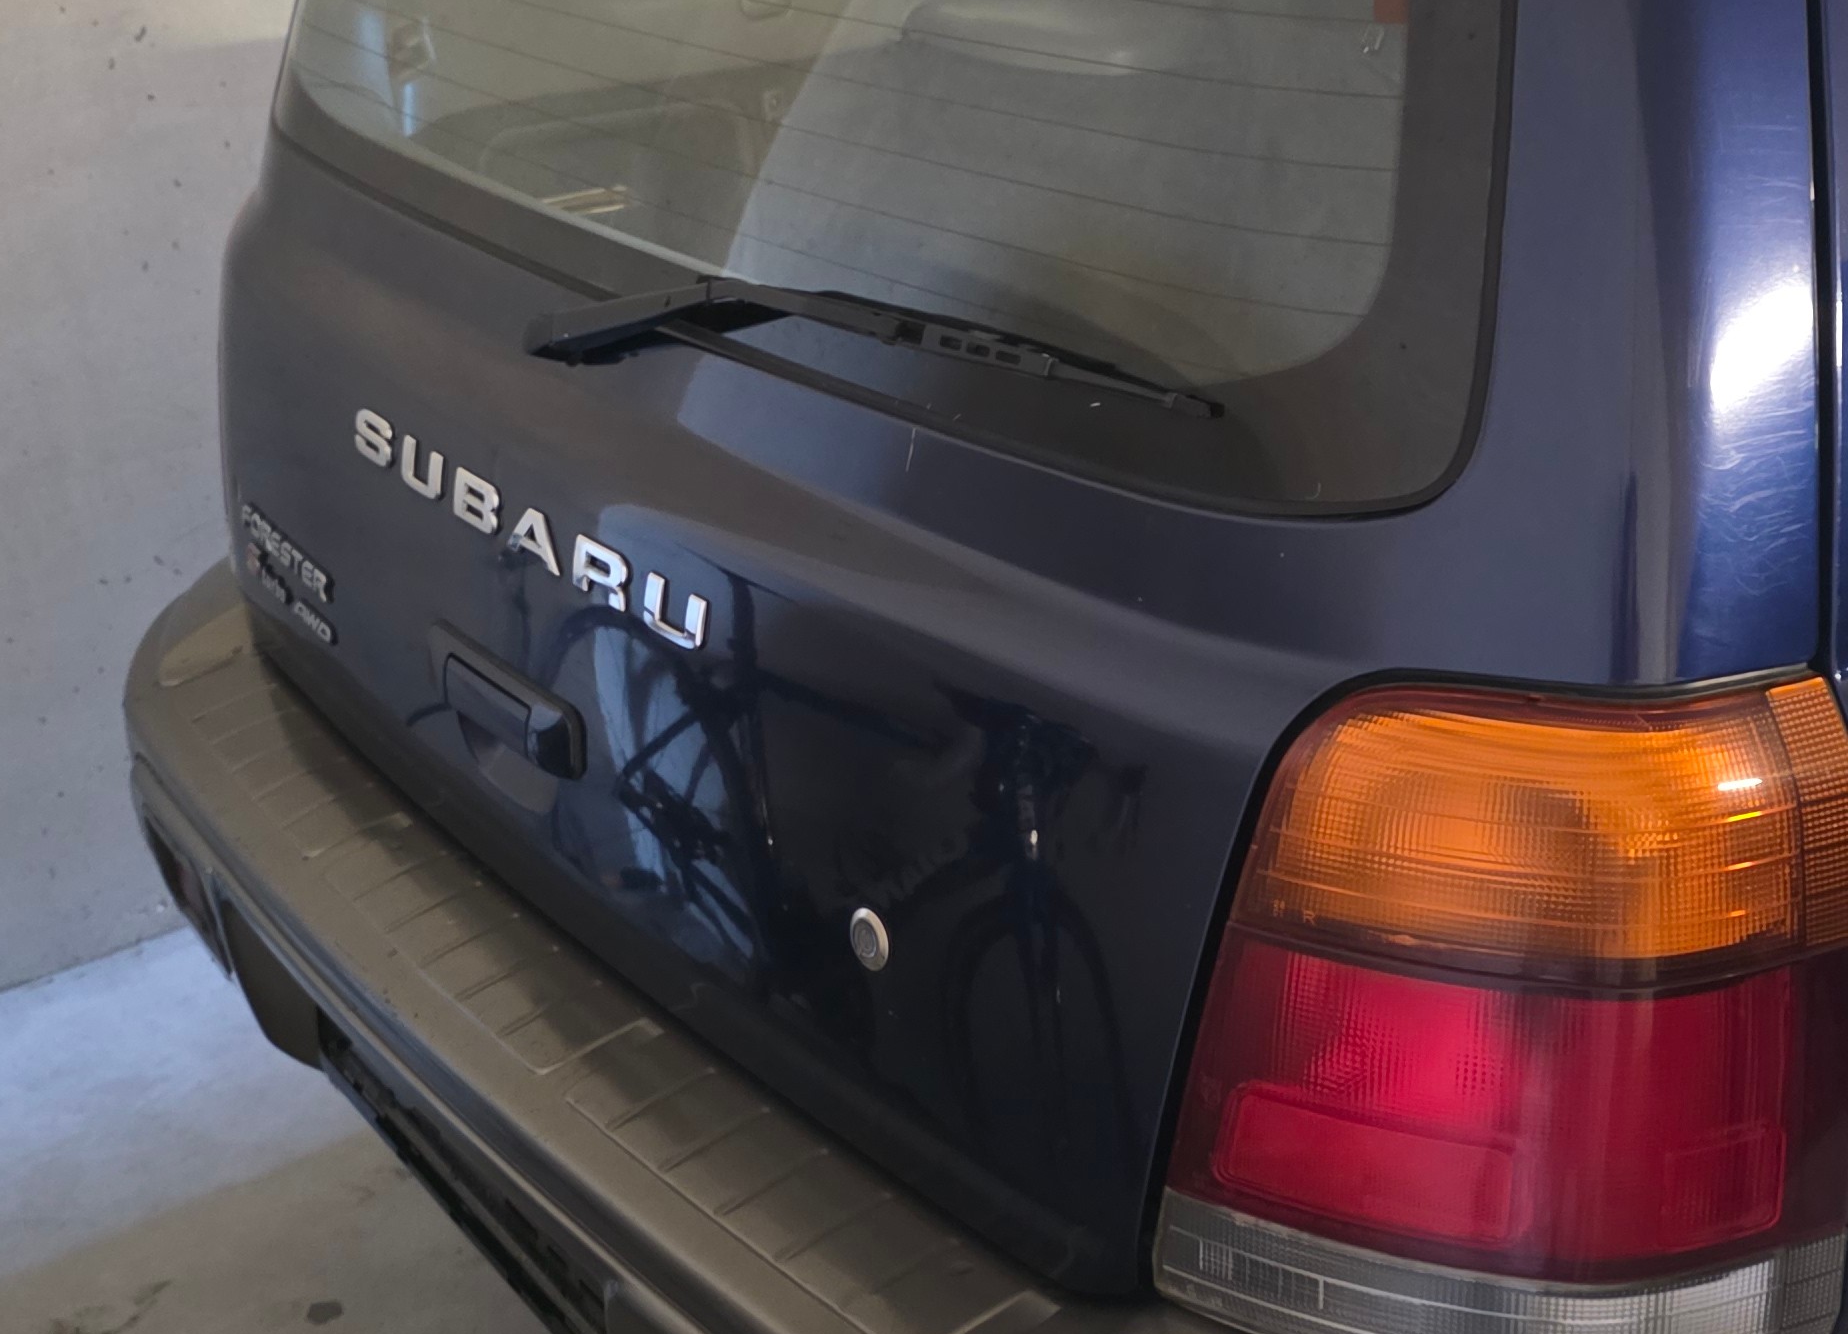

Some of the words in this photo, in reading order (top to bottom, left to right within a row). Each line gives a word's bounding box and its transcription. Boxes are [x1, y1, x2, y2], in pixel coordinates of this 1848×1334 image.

[241, 504, 329, 603] FORESTER
[354, 408, 709, 650] SUBARU
[294, 600, 333, 644] AWD
